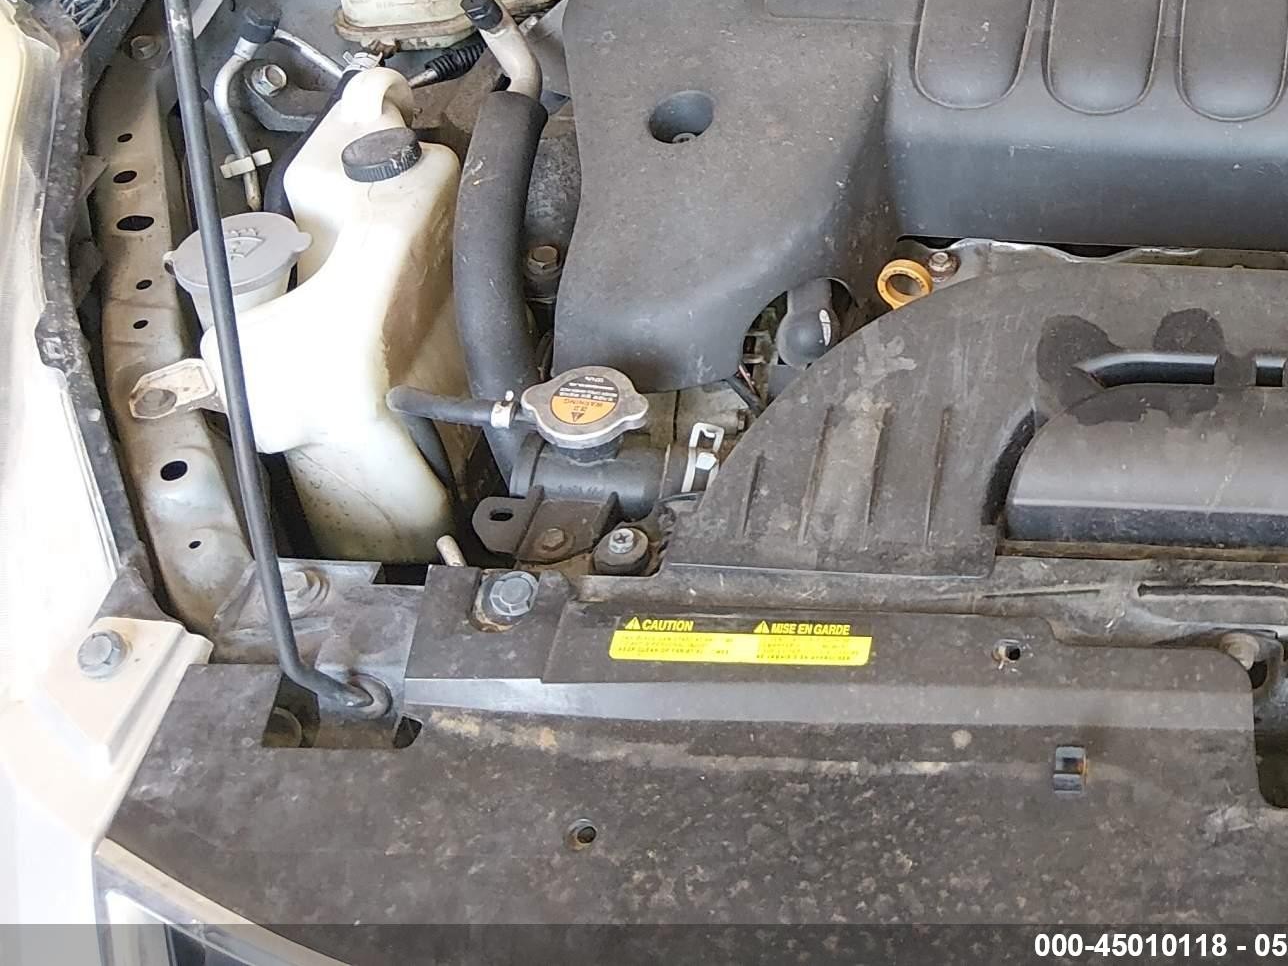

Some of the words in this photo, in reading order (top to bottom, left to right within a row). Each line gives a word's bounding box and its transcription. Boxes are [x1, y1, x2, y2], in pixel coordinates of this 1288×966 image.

[641, 619, 694, 632] CAUTION
[771, 623, 796, 635] MISE
[798, 623, 813, 635] EN
[814, 624, 851, 636] GARDE
